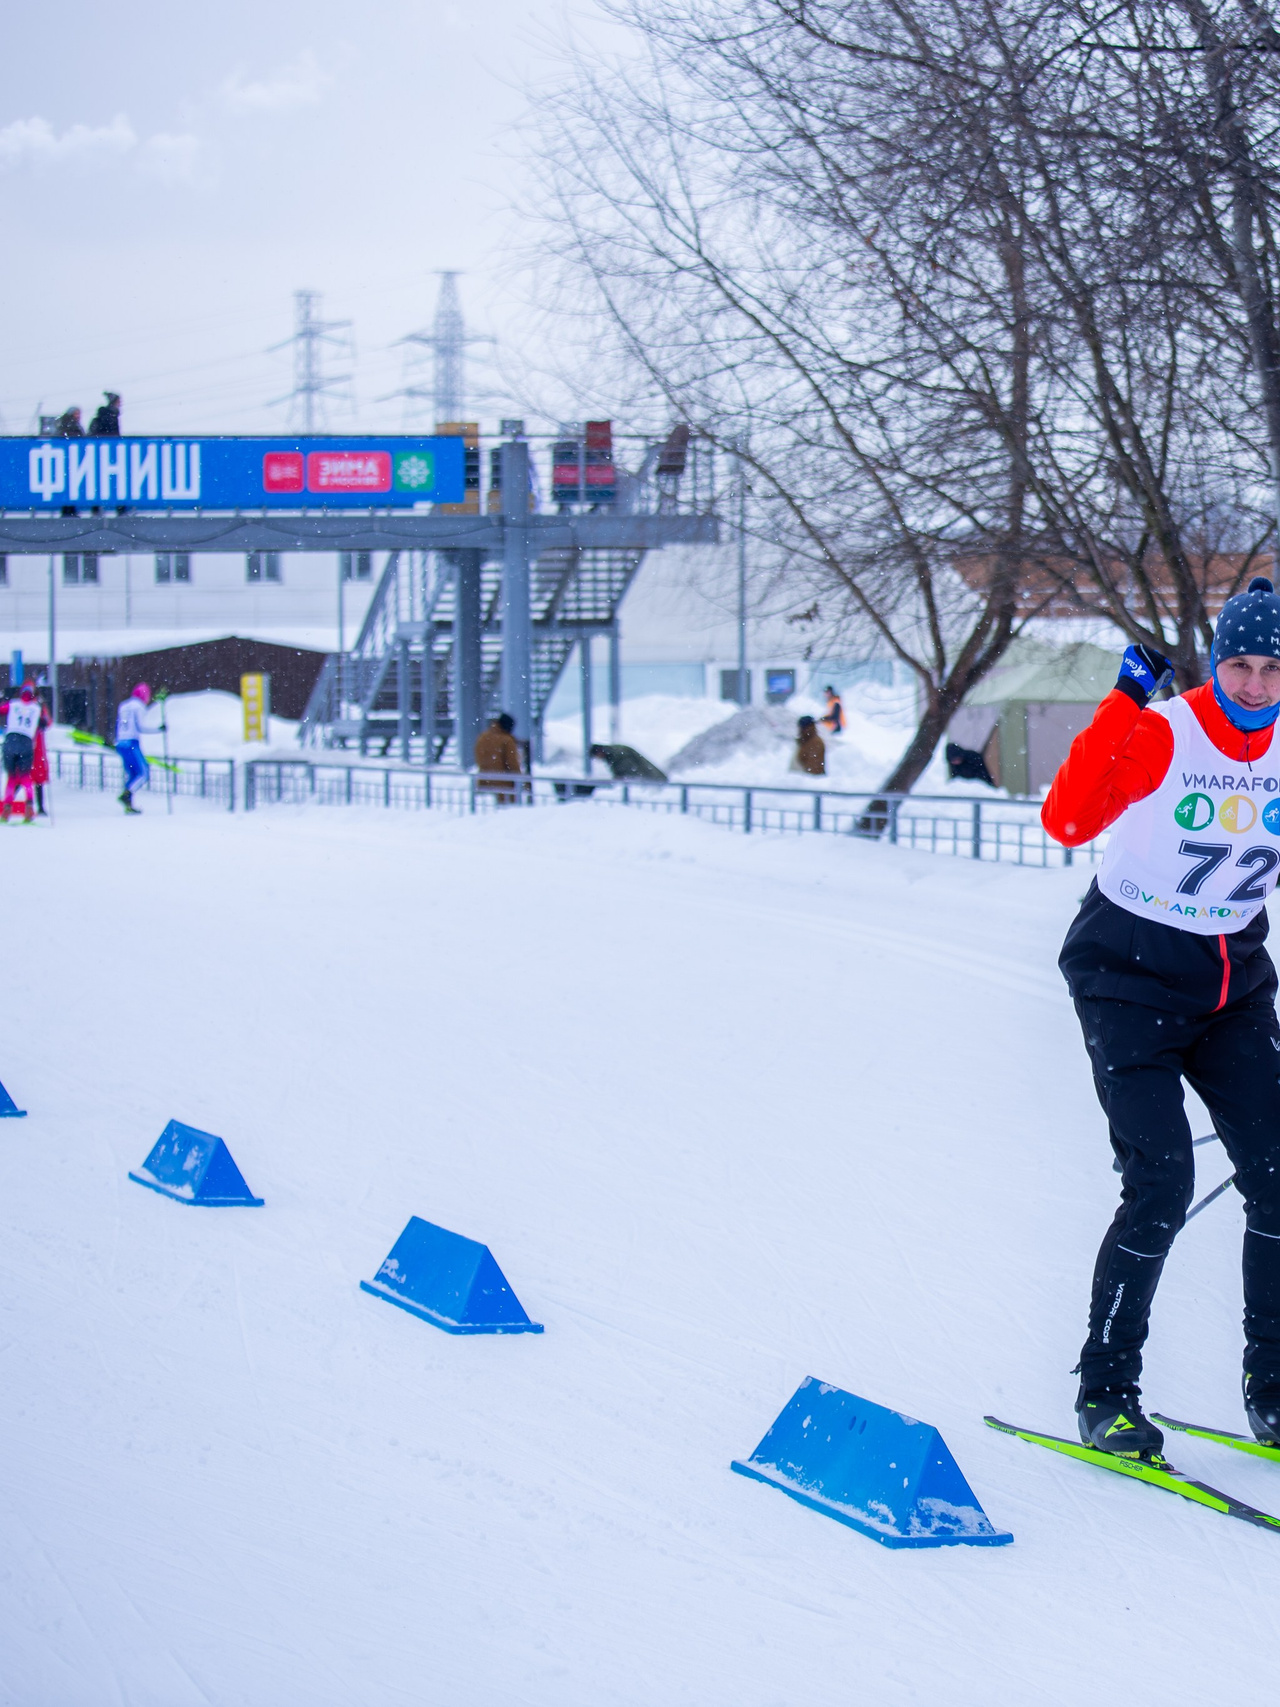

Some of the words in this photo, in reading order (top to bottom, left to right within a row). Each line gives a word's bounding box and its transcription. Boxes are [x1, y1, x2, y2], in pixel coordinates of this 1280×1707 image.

[29, 442, 202, 502] ФИНИШ
[1102, 1318, 1113, 1344] CODE
[1119, 1459, 1144, 1473] FISCHER
